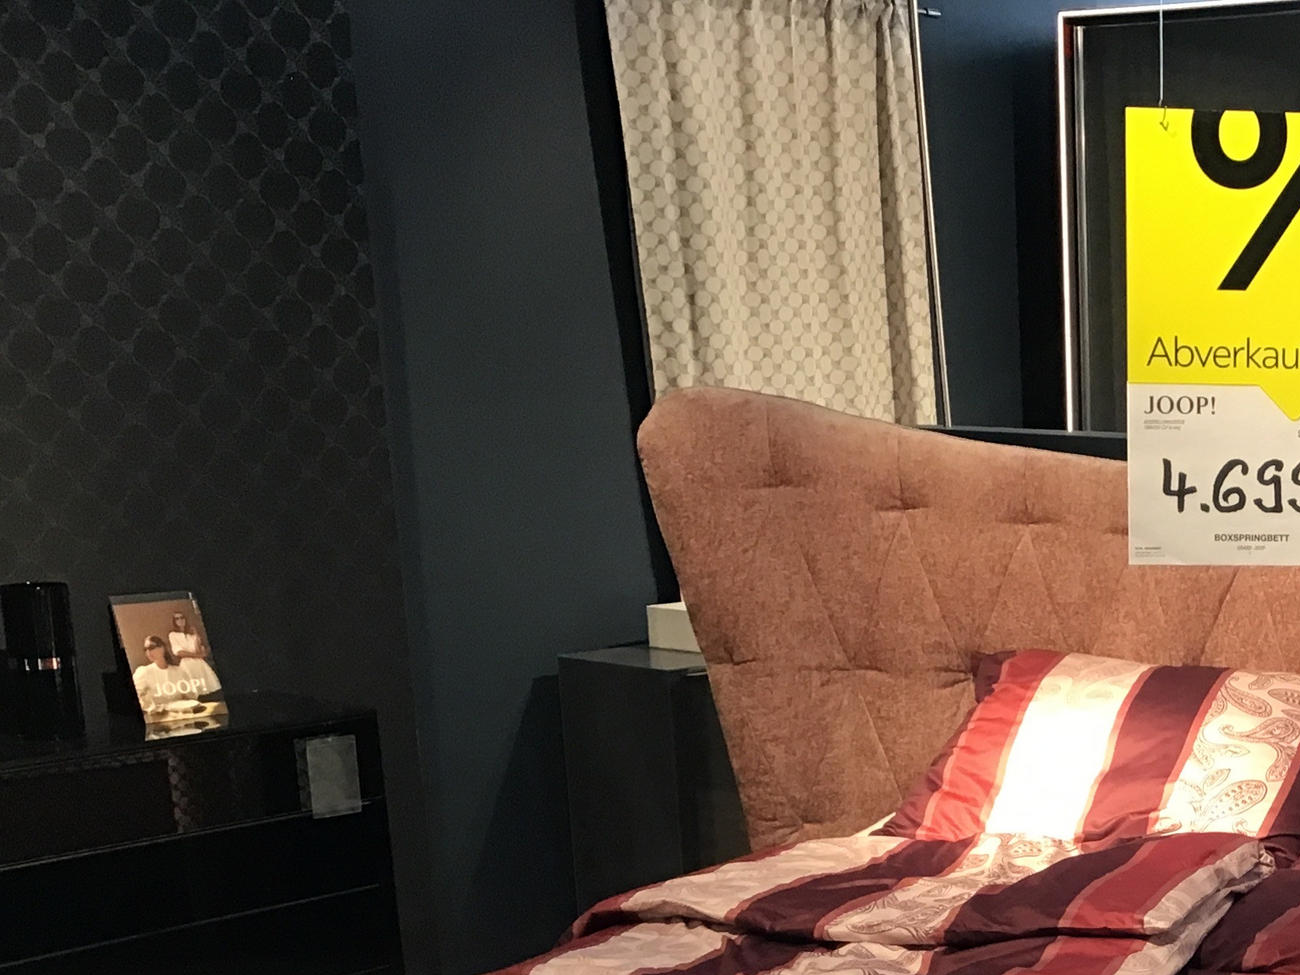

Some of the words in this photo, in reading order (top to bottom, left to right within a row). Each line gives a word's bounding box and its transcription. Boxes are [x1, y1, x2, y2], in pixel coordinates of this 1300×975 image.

[1144, 396, 1216, 415] JOOP!
[1214, 534, 1290, 542] BOXSPRINGBETT
[154, 678, 207, 697] JOOP!
